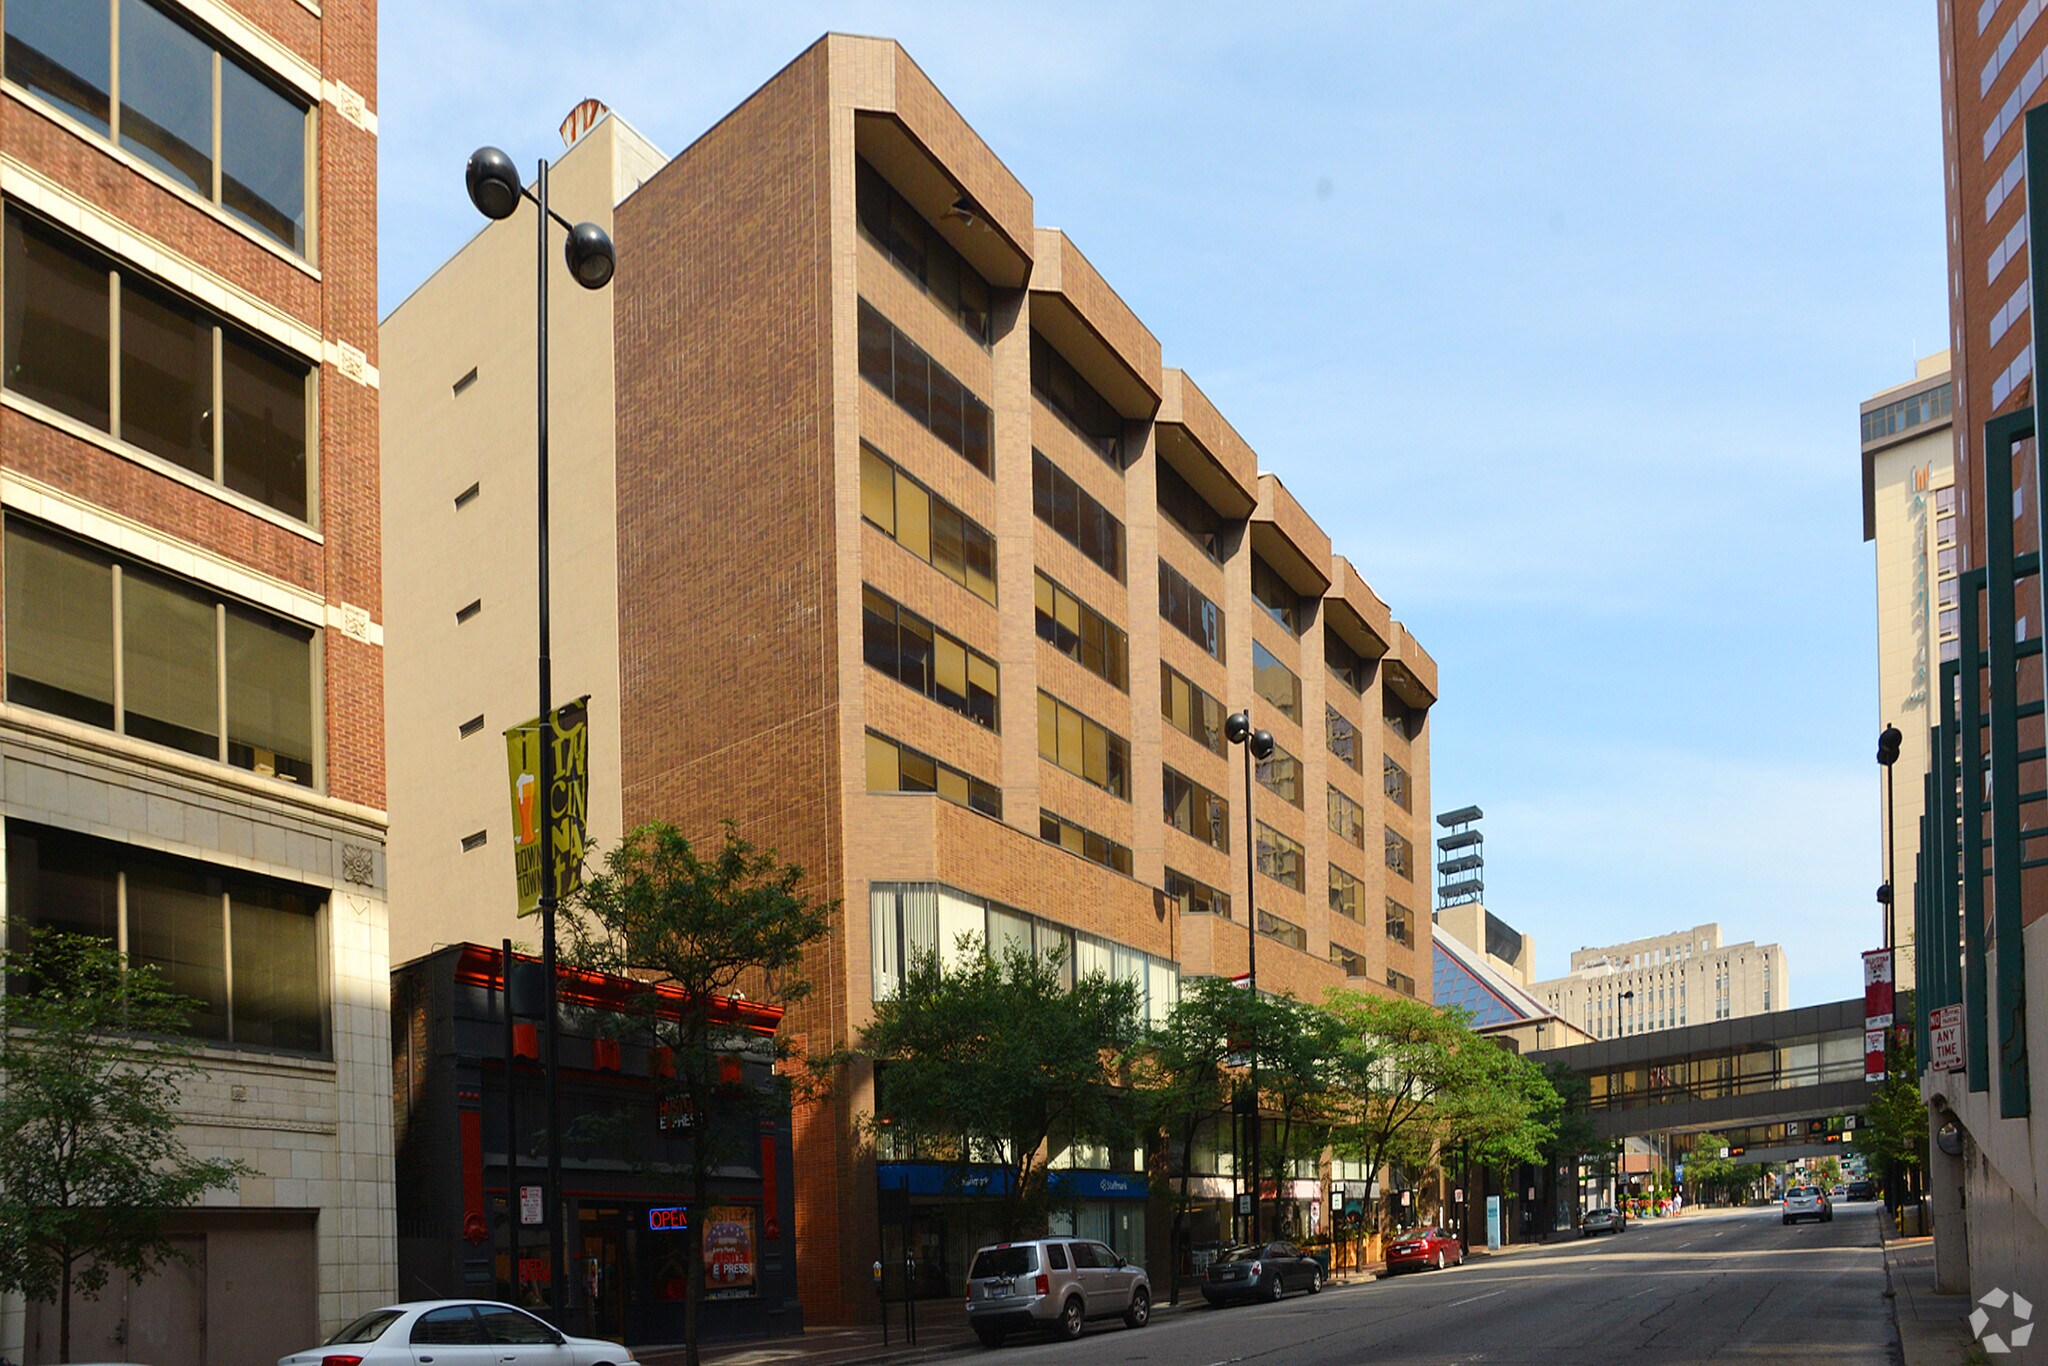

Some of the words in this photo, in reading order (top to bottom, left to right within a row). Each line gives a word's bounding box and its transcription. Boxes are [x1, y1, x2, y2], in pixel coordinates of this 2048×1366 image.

[515, 844, 542, 873] DOWN
[517, 868, 543, 899] TOWN
[1930, 1013, 1940, 1026] NO
[1937, 1028, 1955, 1043] ANY
[1937, 1043, 1957, 1057] TIME
[651, 1210, 688, 1228] OPEN
[713, 1263, 749, 1275] EPRESS
